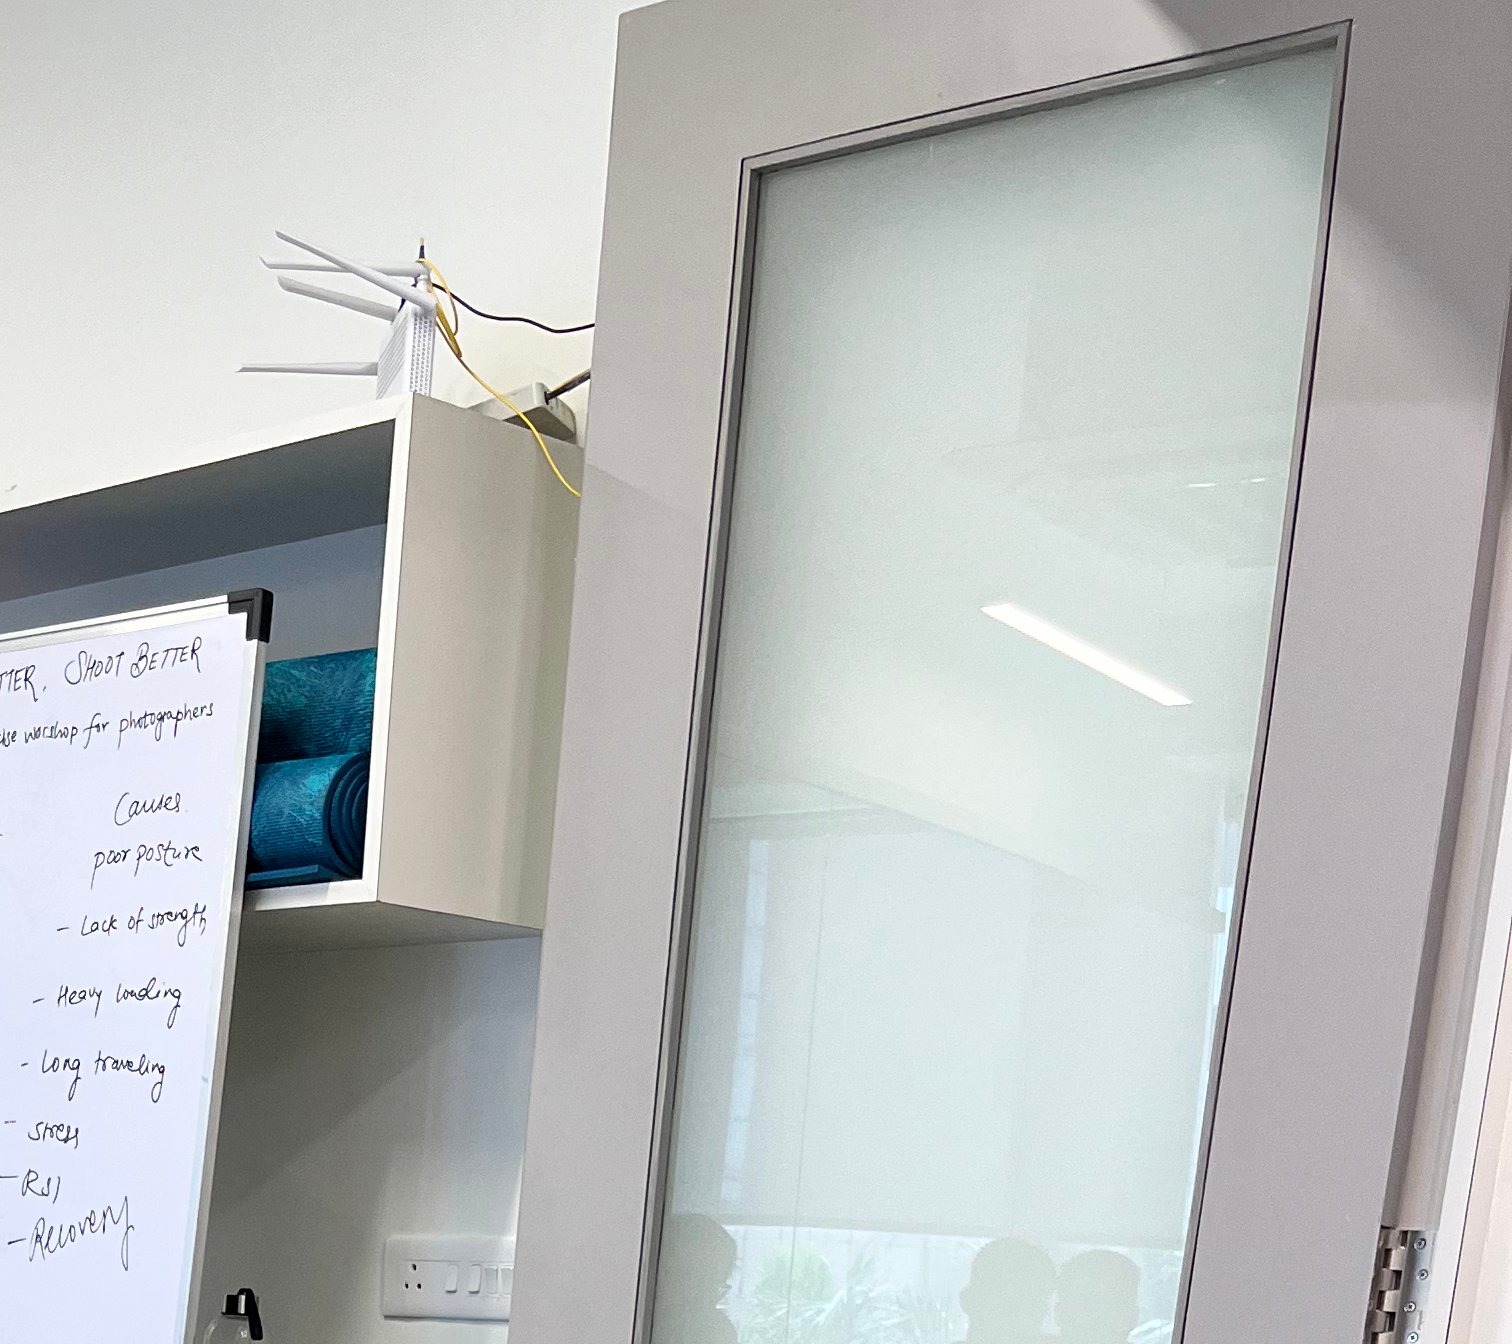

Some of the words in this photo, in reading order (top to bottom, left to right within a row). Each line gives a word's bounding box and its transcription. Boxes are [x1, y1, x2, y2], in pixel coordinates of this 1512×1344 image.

[64, 650, 125, 685] SHOOT
[130, 636, 202, 678] BETTER
[83, 712, 109, 749] for
[117, 702, 214, 750] photographers
[90, 848, 131, 890] poor
[134, 840, 203, 877] posture
[81, 914, 117, 936] Lack
[127, 907, 144, 934] of
[148, 902, 207, 947] strength
[57, 984, 102, 1018] Heavy
[29, 1195, 135, 1271] Recovery
